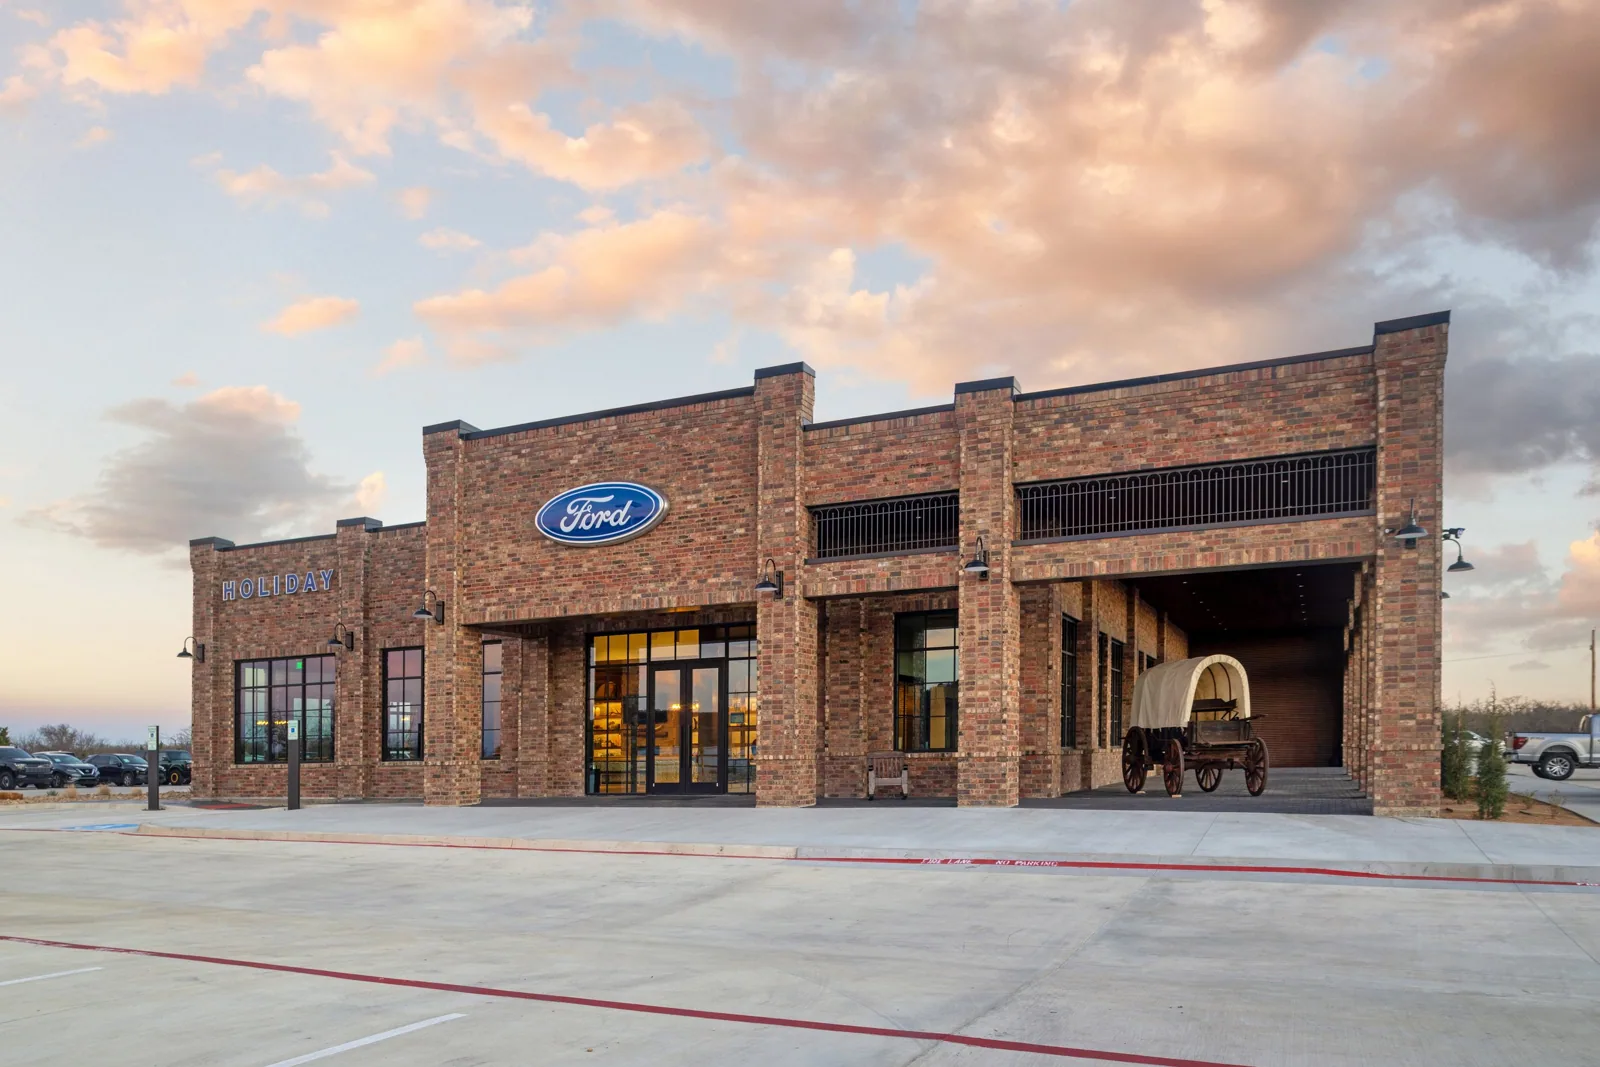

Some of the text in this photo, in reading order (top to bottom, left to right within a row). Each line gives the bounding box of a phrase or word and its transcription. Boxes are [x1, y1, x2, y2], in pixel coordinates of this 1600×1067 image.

[560, 494, 634, 533] Ford
[222, 568, 335, 601] HOLIDAY
[1014, 860, 1058, 868] PARKING
